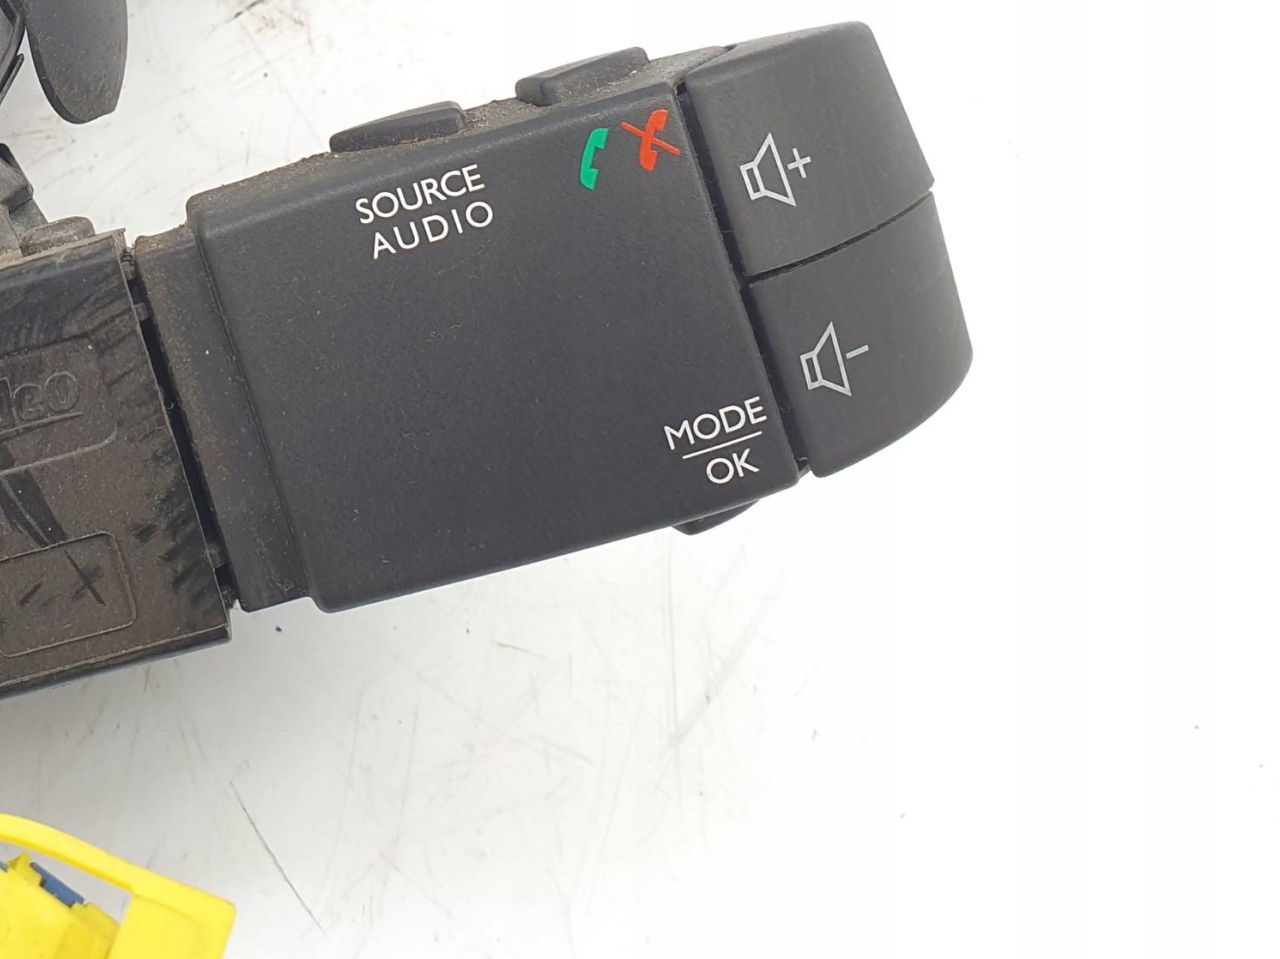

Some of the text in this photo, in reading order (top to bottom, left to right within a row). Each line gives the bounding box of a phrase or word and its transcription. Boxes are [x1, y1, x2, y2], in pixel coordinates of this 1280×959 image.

[355, 163, 486, 225] SOURCE
[372, 200, 495, 260] AUDIO
[663, 395, 768, 451] MODE
[705, 448, 761, 485] OK
